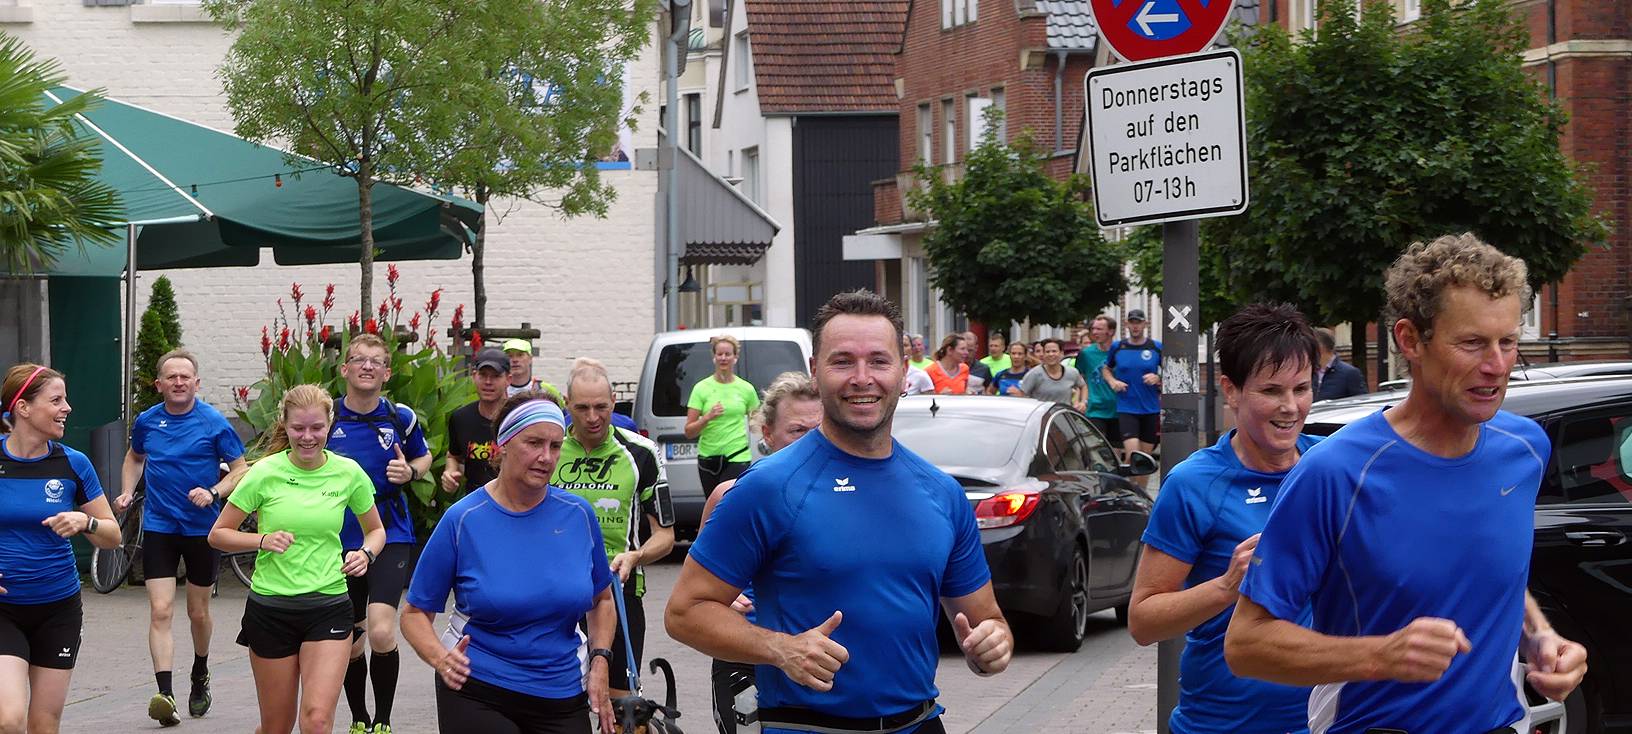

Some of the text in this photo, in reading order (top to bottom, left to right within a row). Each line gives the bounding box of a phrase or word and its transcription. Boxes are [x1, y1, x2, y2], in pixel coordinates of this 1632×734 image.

[1102, 77, 1223, 109] Donnerstags
[1126, 111, 1199, 138] auf den
[1109, 142, 1222, 174] Parkflächen
[1134, 176, 1196, 203] 07-13h
